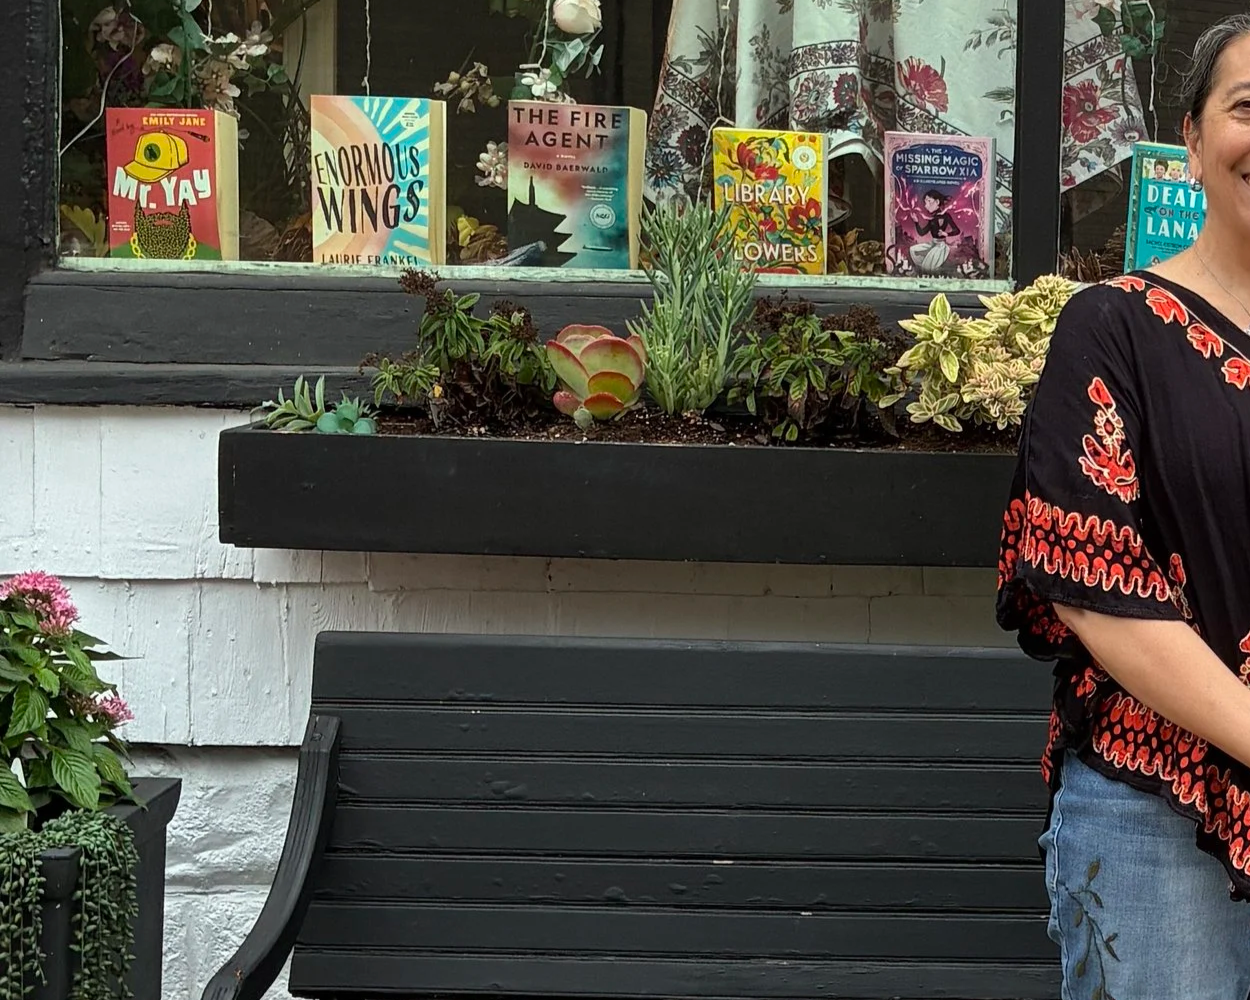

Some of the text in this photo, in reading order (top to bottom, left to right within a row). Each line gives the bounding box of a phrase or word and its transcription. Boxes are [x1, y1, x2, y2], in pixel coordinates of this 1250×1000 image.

[142, 116, 206, 126] EMILY JANE
[513, 107, 623, 129] THE FIRE
[524, 131, 609, 149] AGENT
[314, 142, 420, 187] ENORMOUS
[523, 161, 608, 173] DAVID BAERWALD
[895, 153, 979, 166] MISSING MAGIC
[904, 165, 957, 175] SPARROW
[959, 168, 978, 177] XIA
[113, 166, 157, 209] Mr.
[724, 182, 810, 205] LIBRARY
[316, 179, 424, 234] WINGS
[1159, 207, 1199, 220] ON THE
[1146, 216, 1199, 240] LANA
[734, 242, 818, 262] LOWERS
